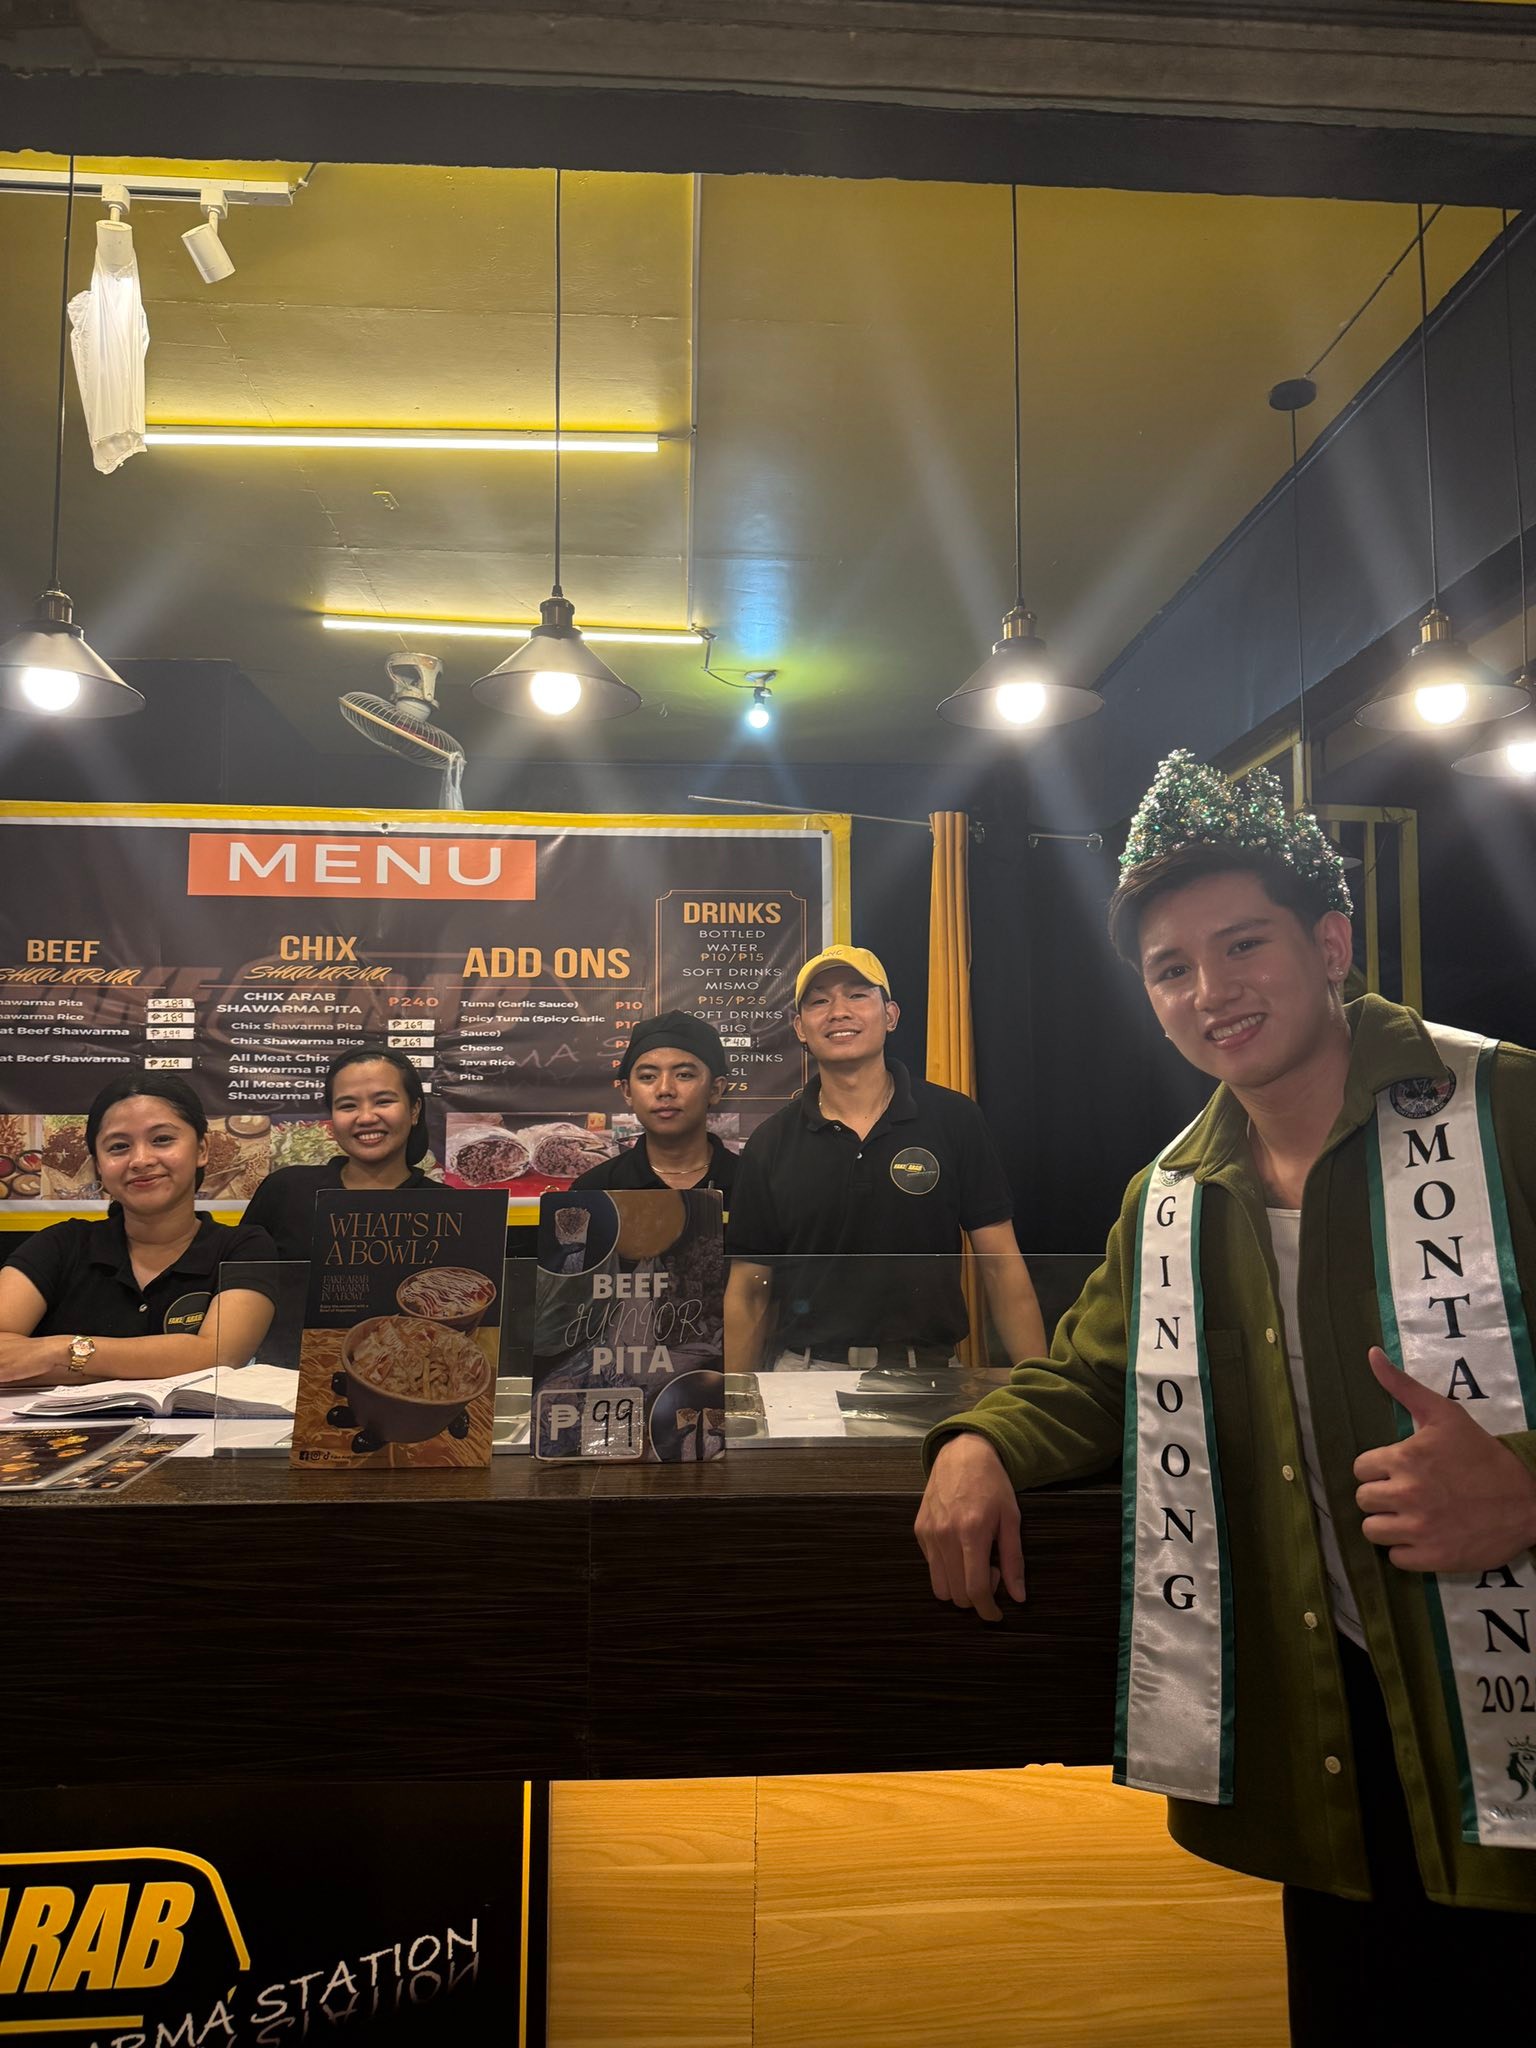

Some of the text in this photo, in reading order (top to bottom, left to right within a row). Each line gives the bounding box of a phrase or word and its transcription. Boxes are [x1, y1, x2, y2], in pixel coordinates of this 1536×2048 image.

[228, 842, 501, 886] MENU
[683, 902, 782, 925] DRINKS
[699, 930, 766, 939] BOTTLED
[27, 939, 100, 963] BEEF
[280, 935, 357, 961] CHIX
[707, 943, 758, 952] WATER
[462, 947, 631, 979] ADD ONS
[682, 968, 783, 977] SOFT DRINKS
[705, 981, 759, 990] MISMO
[244, 992, 336, 1001] CHIX ARAB
[58, 999, 83, 1007] Pita
[460, 1000, 579, 1009] Tuma (Garlic Sauce)
[216, 1004, 362, 1014] SHAWARMA PITA
[0, 1013, 85, 1021] awarma Rice
[460, 1015, 606, 1024] Spicy Tuma (Spicy Garlic
[729, 1011, 783, 1020] DRINKS
[0, 1026, 130, 1036] at Beef Shawarma
[231, 1022, 363, 1031] Chix Shawarma Pita
[720, 1024, 747, 1033] BIG
[460, 1029, 501, 1038] Sauce)
[230, 1037, 365, 1046] Chix Shawarma Rice
[459, 1044, 504, 1052] Cheese
[16, 1055, 51, 1063] Beef
[52, 1055, 130, 1063] Shawarma
[229, 1053, 330, 1062] All Meat Chix
[729, 1054, 784, 1062] DRINKS
[459, 1059, 516, 1067] Java Rice
[228, 1065, 330, 1074] Shawarma Ri
[459, 1073, 484, 1081] Pita
[228, 1080, 249, 1089] All
[253, 1080, 290, 1089] Meat
[728, 1082, 748, 1091] 75
[228, 1092, 311, 1101] Shawarma
[329, 1212, 463, 1239] WHAT'S IN
[325, 1239, 439, 1266] A BOWL?
[593, 1272, 670, 1300] BEEF
[564, 1299, 704, 1347] JUNIOR
[592, 1345, 674, 1375] PITA
[1154, 1195, 1197, 1610] GINOONG
[592, 1399, 635, 1447] 99
[1476, 1675, 1536, 1713] 202
[0, 1881, 195, 1994] RAB
[250, 1918, 479, 2024] STATION
